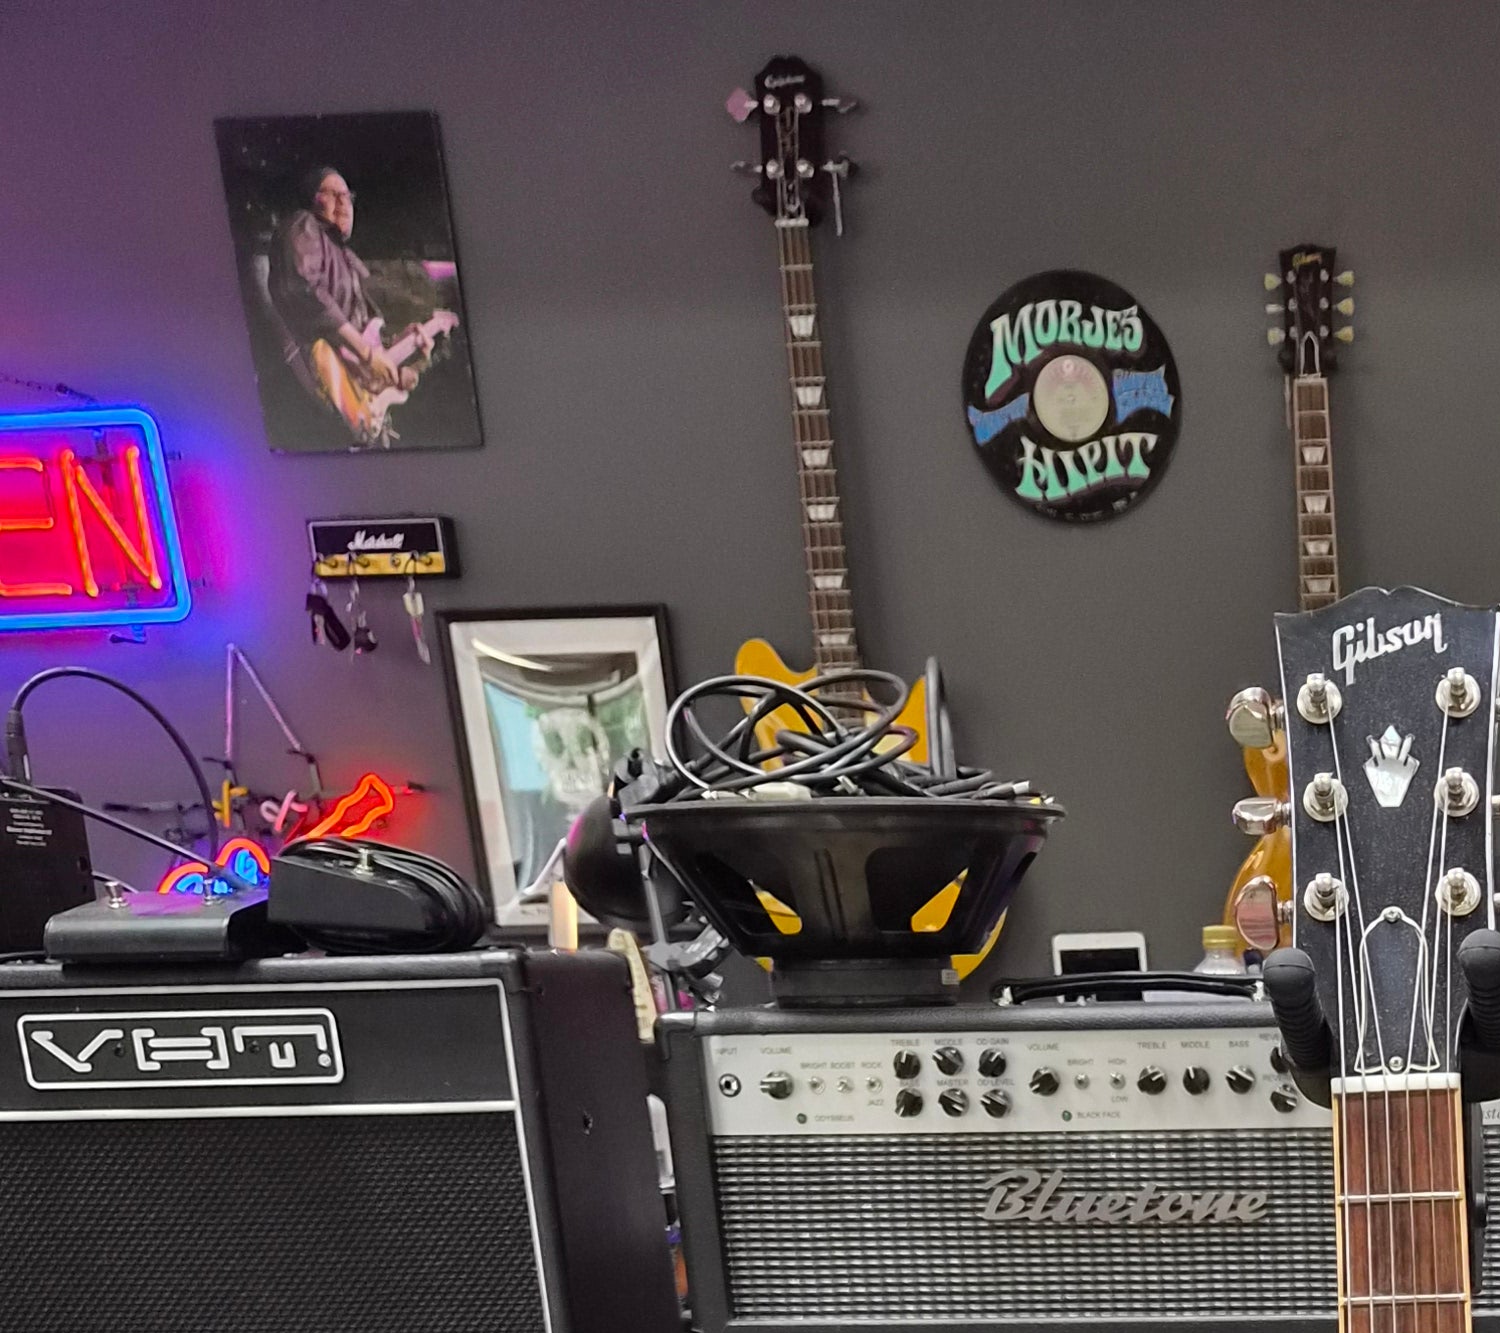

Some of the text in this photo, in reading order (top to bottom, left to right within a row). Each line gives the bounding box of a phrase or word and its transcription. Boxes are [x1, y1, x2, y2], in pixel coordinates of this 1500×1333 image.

[985, 299, 1144, 399] MORJES
[1332, 612, 1448, 687] Gibson
[982, 1168, 1268, 1223] Bluetone
